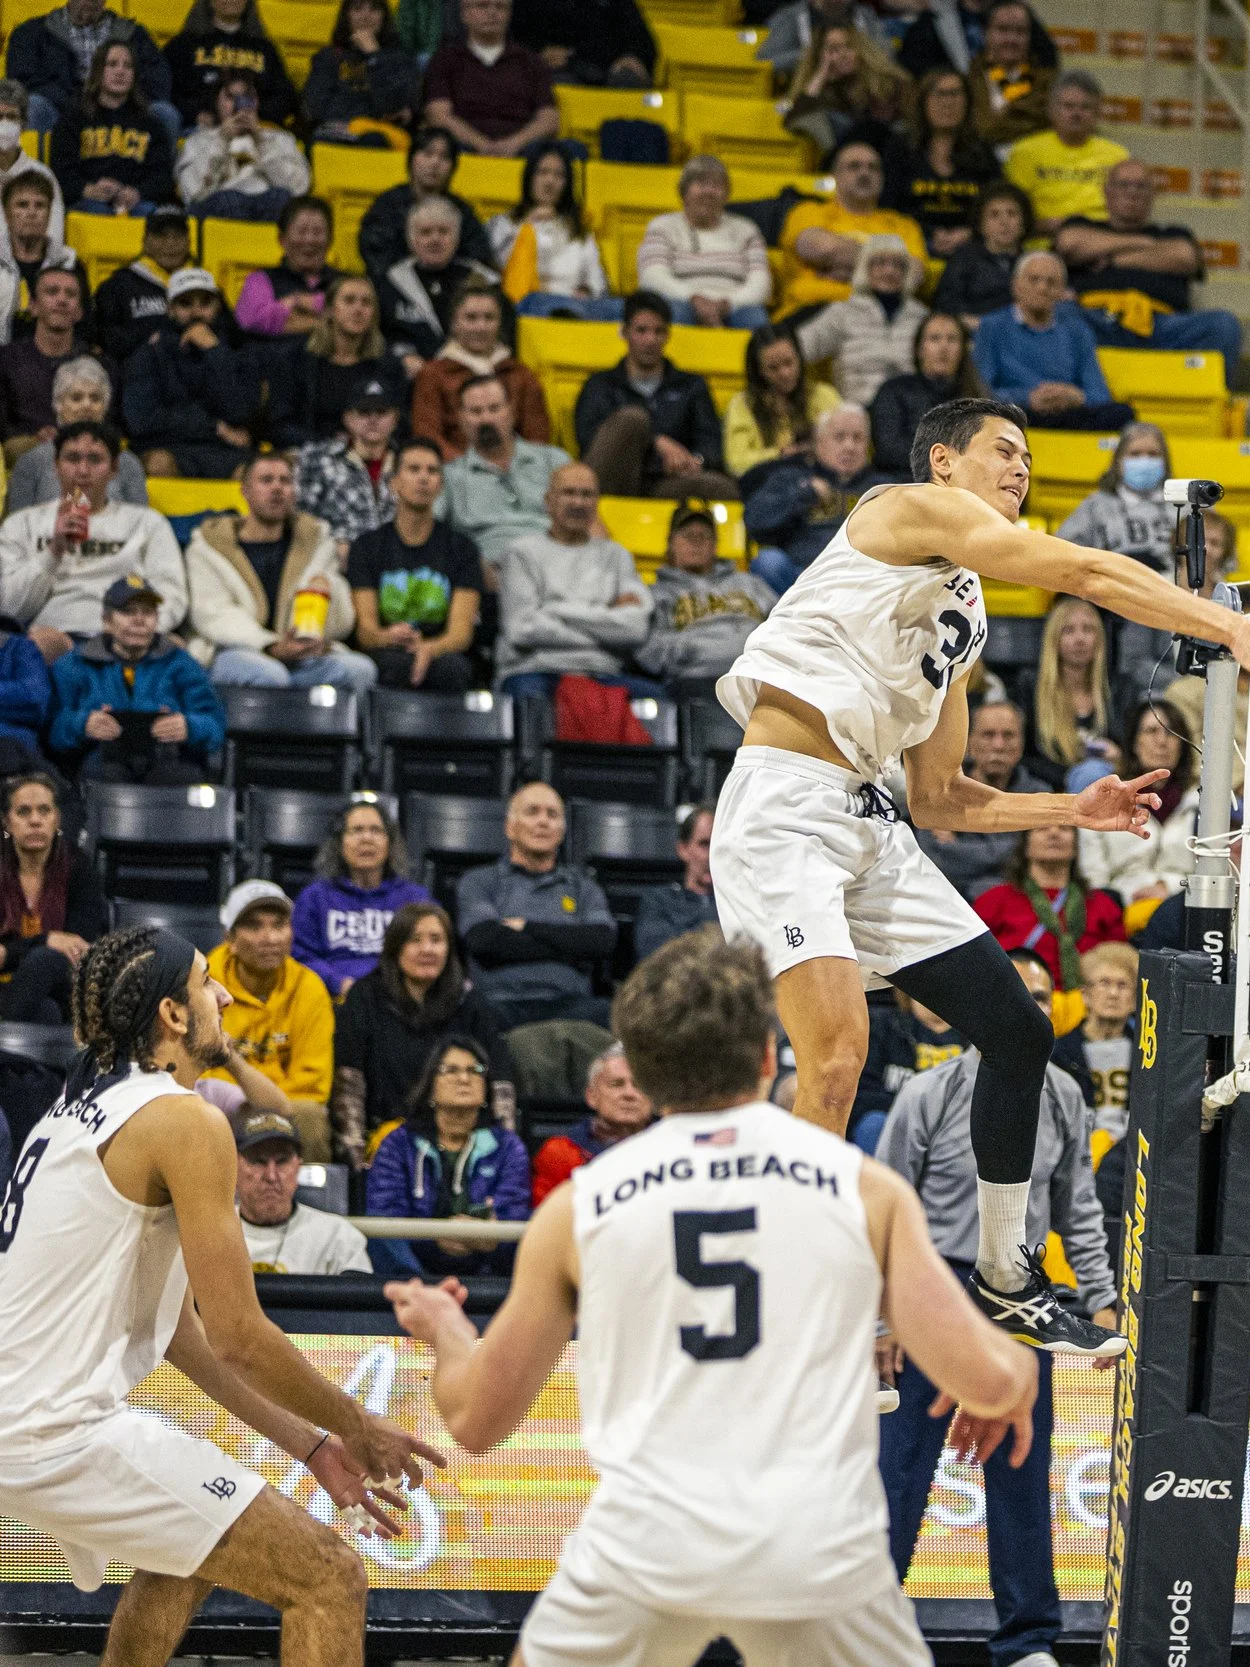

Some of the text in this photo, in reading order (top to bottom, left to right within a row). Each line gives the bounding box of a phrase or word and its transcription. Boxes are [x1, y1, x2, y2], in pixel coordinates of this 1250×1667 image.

[593, 1154, 839, 1217] LONG BEACH
[1131, 1128, 1150, 1294] LONG
[673, 1206, 760, 1363] 5
[1118, 1303, 1139, 1505] BEACH
